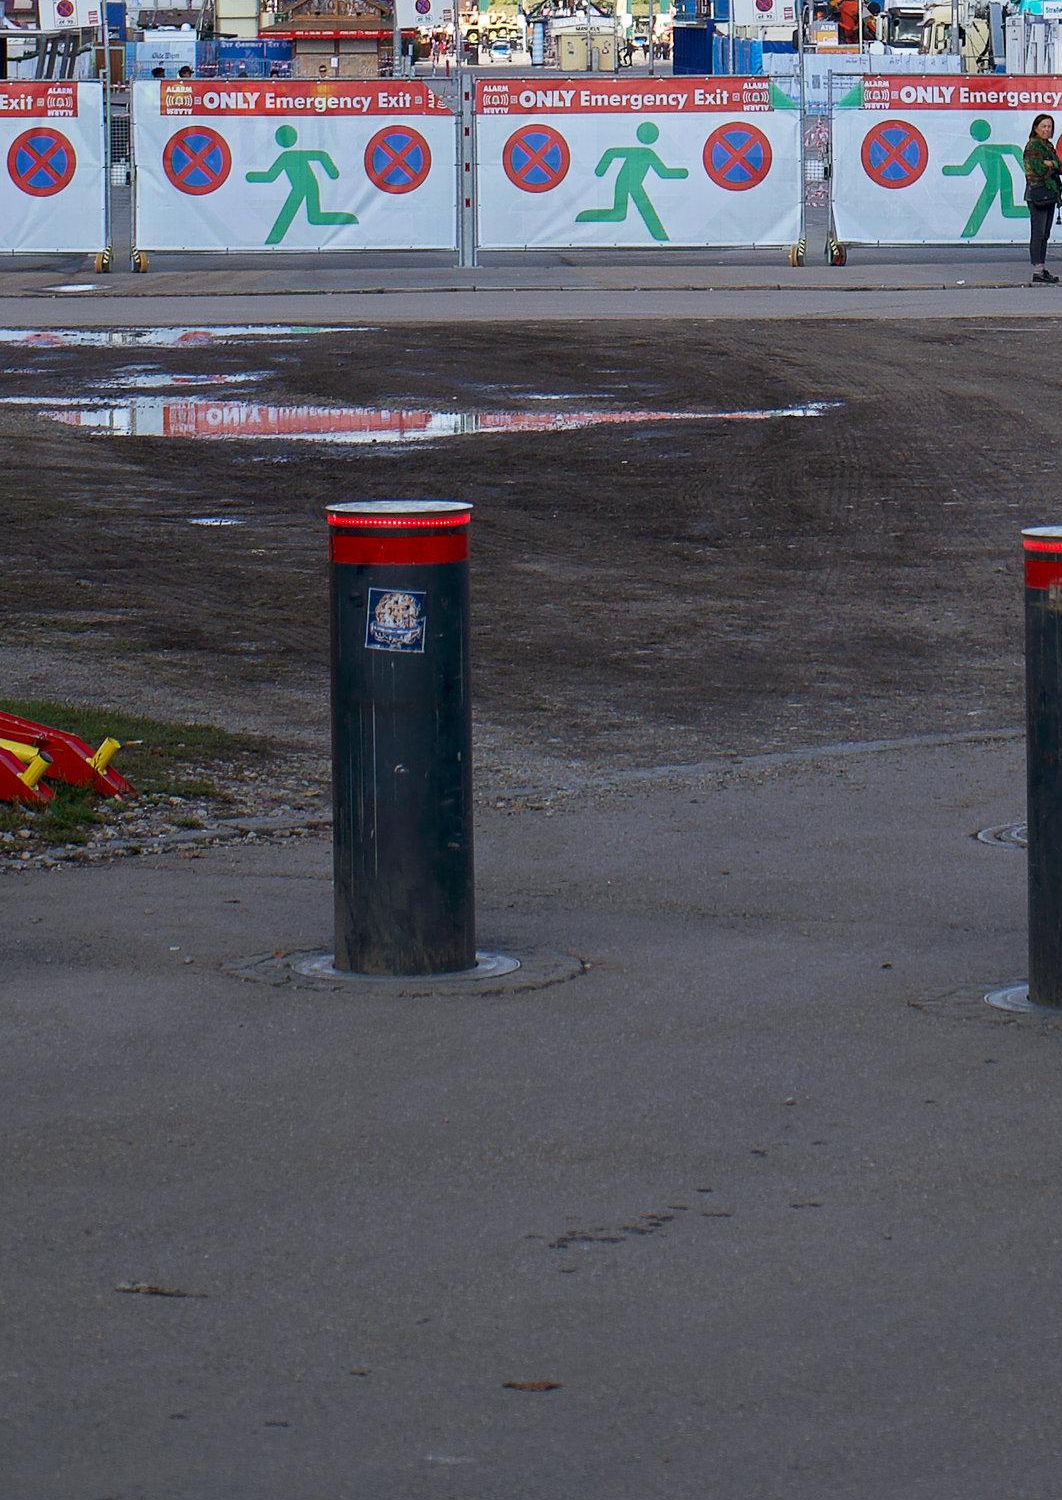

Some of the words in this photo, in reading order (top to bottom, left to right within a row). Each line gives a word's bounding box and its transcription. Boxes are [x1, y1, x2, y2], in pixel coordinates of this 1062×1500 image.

[0, 94, 33, 110] Exit
[203, 91, 260, 109] ONLY
[265, 92, 372, 112] Emergency
[378, 92, 411, 108] Exit
[519, 90, 576, 108] ONLY
[580, 90, 688, 110] Emergency
[694, 89, 729, 105] Exit
[900, 86, 955, 104] ONLY
[960, 86, 1062, 107] Emergency
